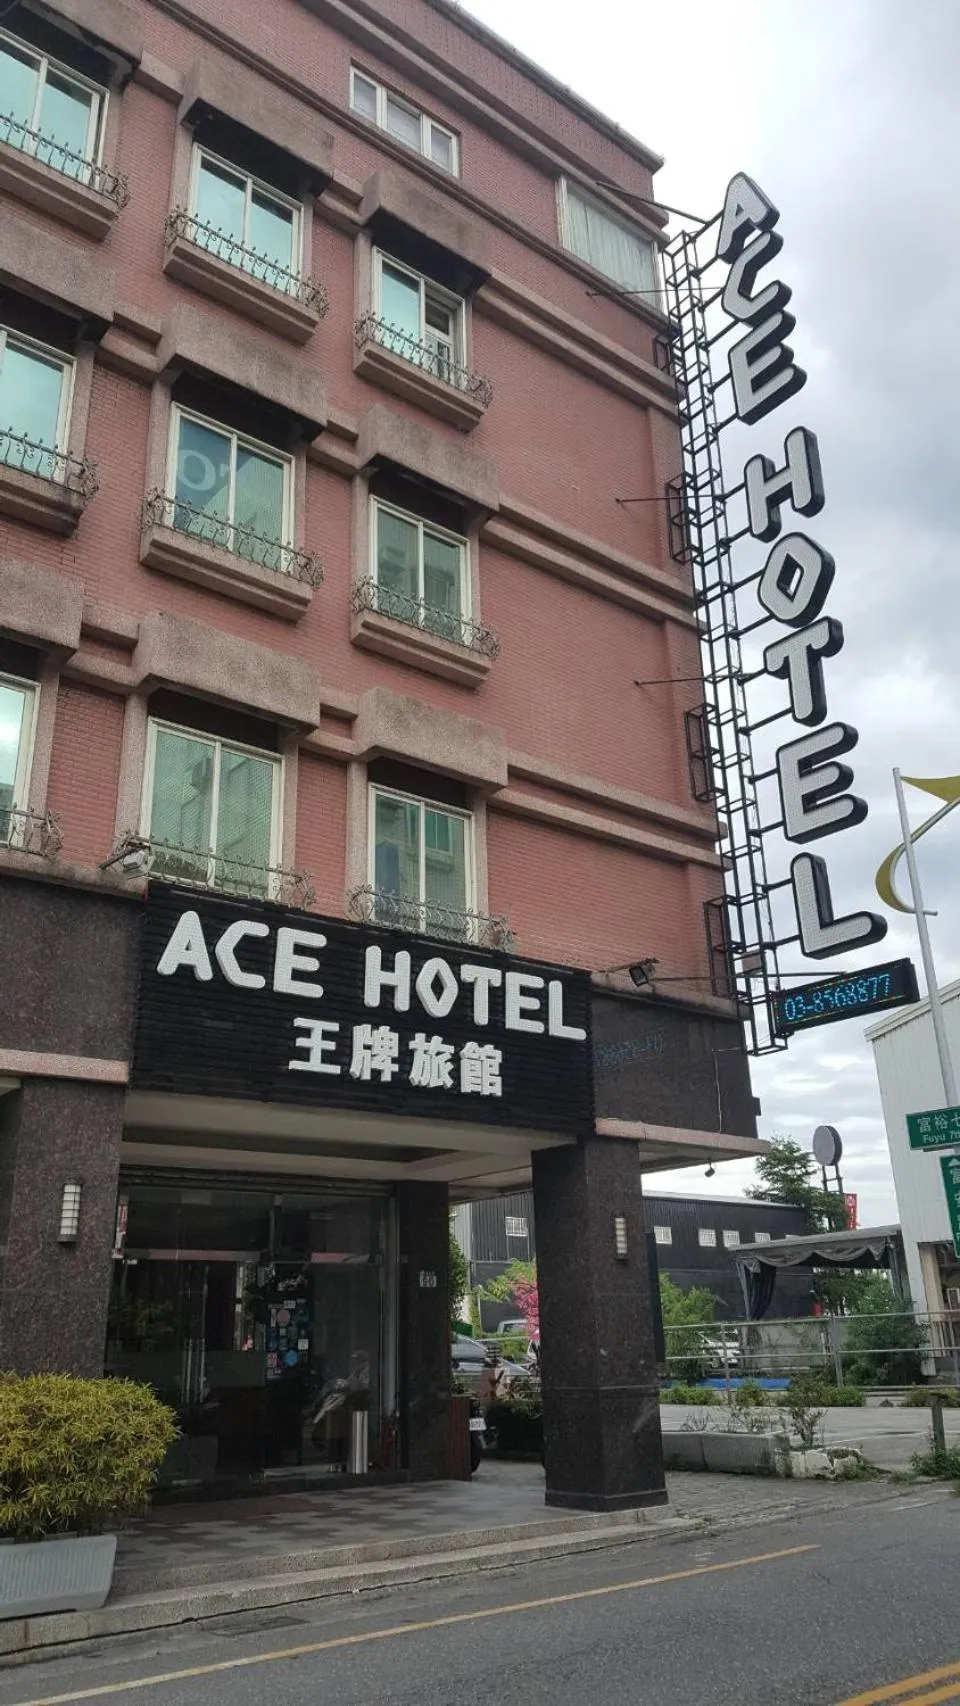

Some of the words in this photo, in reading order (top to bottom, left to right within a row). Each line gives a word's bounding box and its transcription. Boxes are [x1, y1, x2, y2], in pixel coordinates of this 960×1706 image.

[716, 171, 807, 425] ACE
[743, 425, 889, 960] HOTEL
[157, 911, 327, 998] ACE
[364, 945, 588, 1041] HOTEL
[288, 1017, 503, 1097] 王牌旅館
